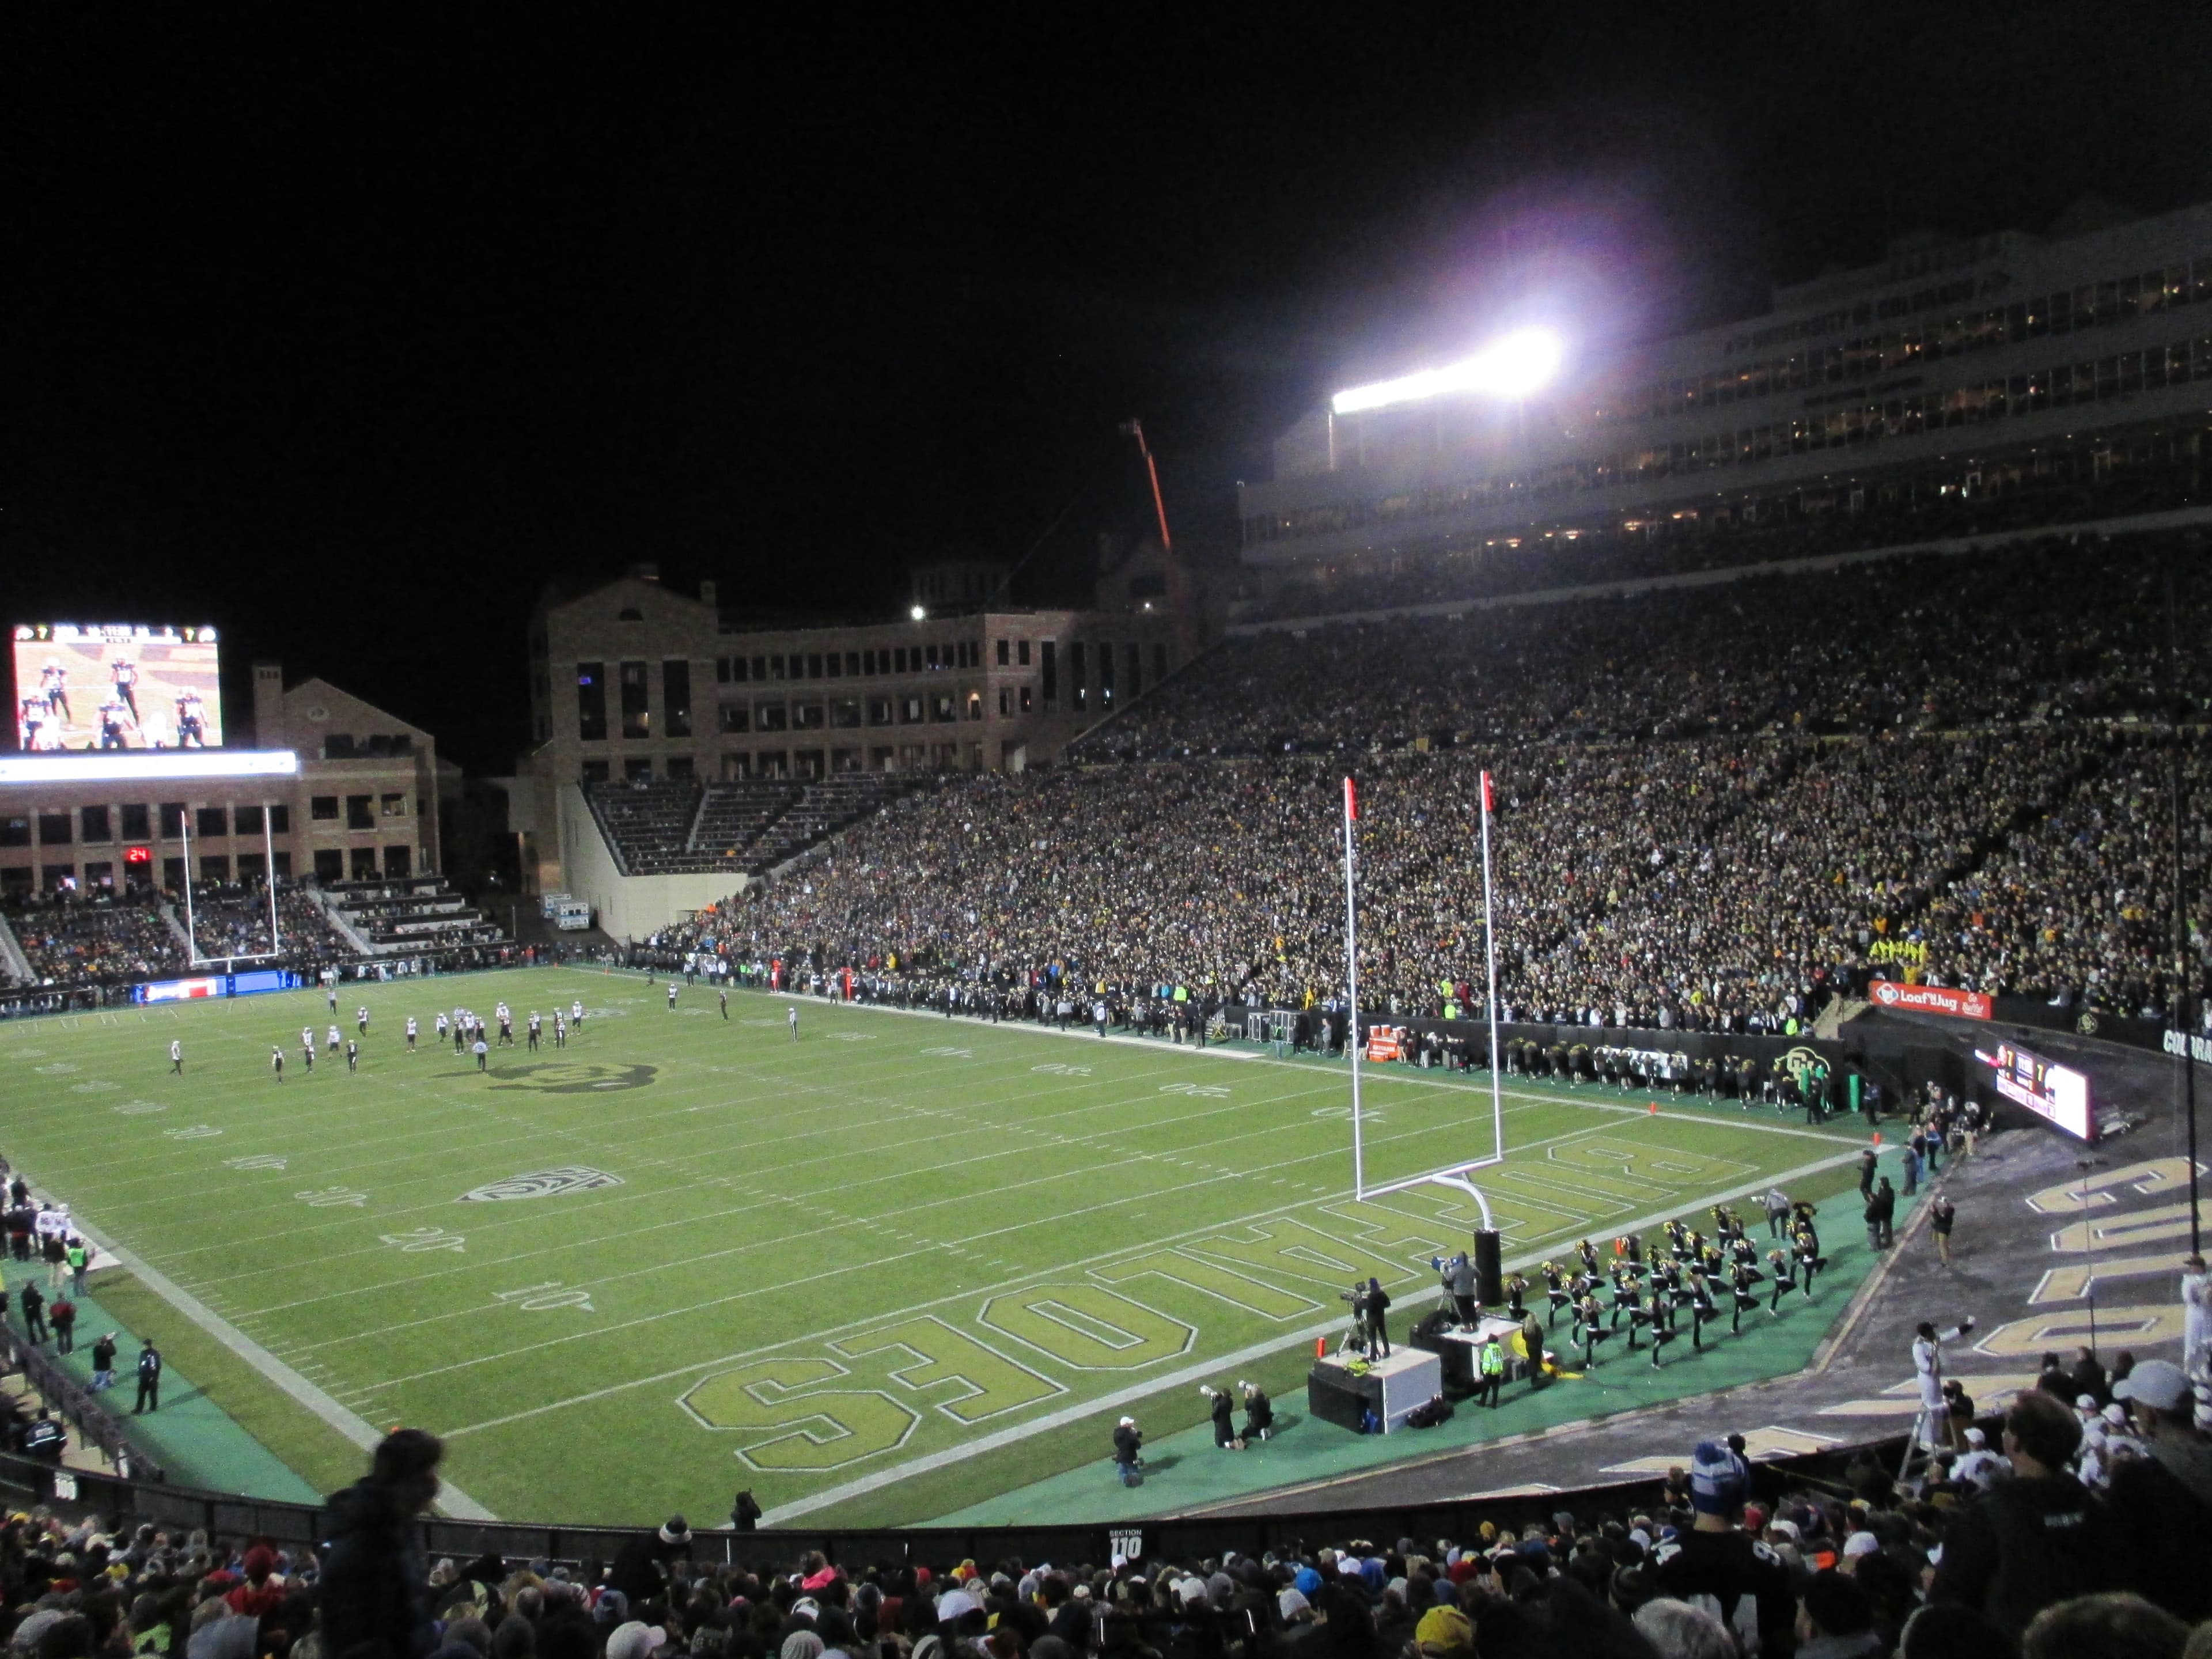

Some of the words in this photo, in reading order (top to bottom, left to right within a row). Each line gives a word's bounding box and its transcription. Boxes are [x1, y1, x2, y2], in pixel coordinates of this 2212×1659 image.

[130, 850, 146, 859] 24
[1901, 989, 1927, 1004] Loaf
[379, 1226, 465, 1252] 20
[491, 1281, 591, 1310] 10
[1109, 1529, 1142, 1537] SECTION
[1111, 1536, 1142, 1559] 110
